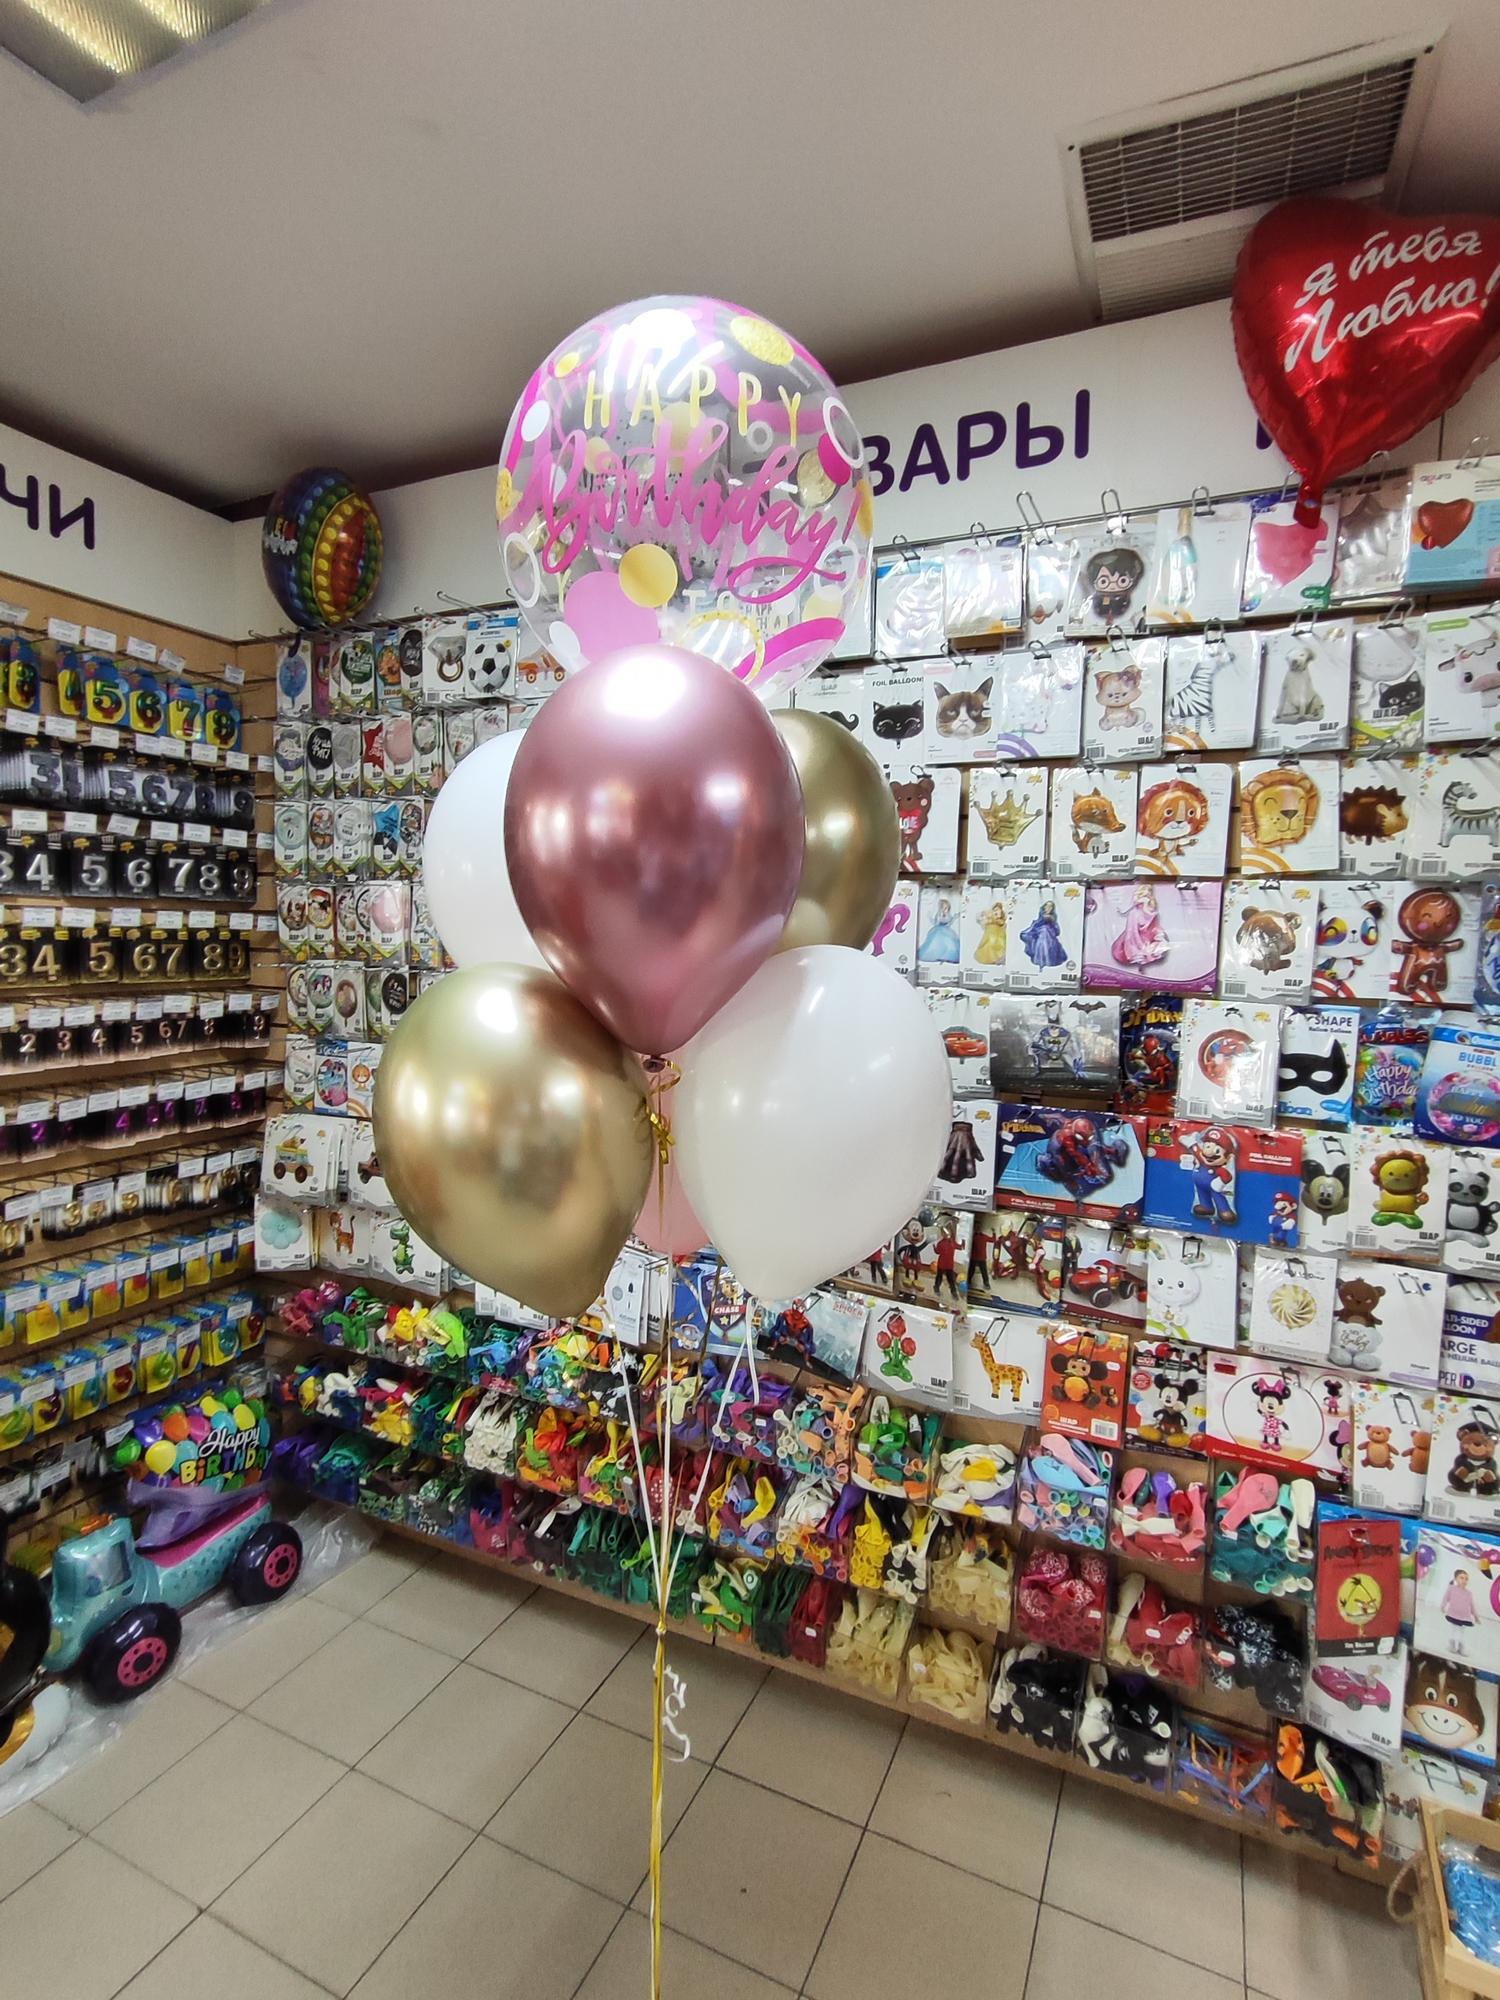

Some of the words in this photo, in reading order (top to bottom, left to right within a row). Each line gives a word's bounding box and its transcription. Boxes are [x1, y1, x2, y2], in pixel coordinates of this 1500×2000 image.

[1350, 226, 1482, 281] тебя
[583, 363, 801, 448] HAPPY
[872, 679, 888, 688] FOIL
[1319, 721, 1339, 732] ШАР
[1371, 708, 1400, 719] ШАР
[1137, 735, 1155, 745] ШАР
[26, 853, 54, 887] 4
[81, 855, 108, 887] 5
[1022, 855, 1039, 864] ШАР
[1112, 854, 1130, 863] ШАР
[127, 858, 151, 888] 6
[168, 858, 195, 889] 7
[199, 864, 221, 892] 8
[0, 944, 27, 977] 3
[32, 944, 61, 980] 4
[89, 942, 114, 975] 5
[133, 943, 157, 975] 6
[161, 944, 184, 976] 7
[1284, 978, 1304, 987] ШАР
[1314, 1015, 1353, 1028] SHAPE
[1366, 1061, 1412, 1085] Happy
[971, 1188, 987, 1196] ШАР
[1419, 1231, 1440, 1241] ШАР
[930, 1376, 949, 1388] ШАР
[199, 1427, 261, 1458] Happy
[1371, 1732, 1392, 1746] ШАР
